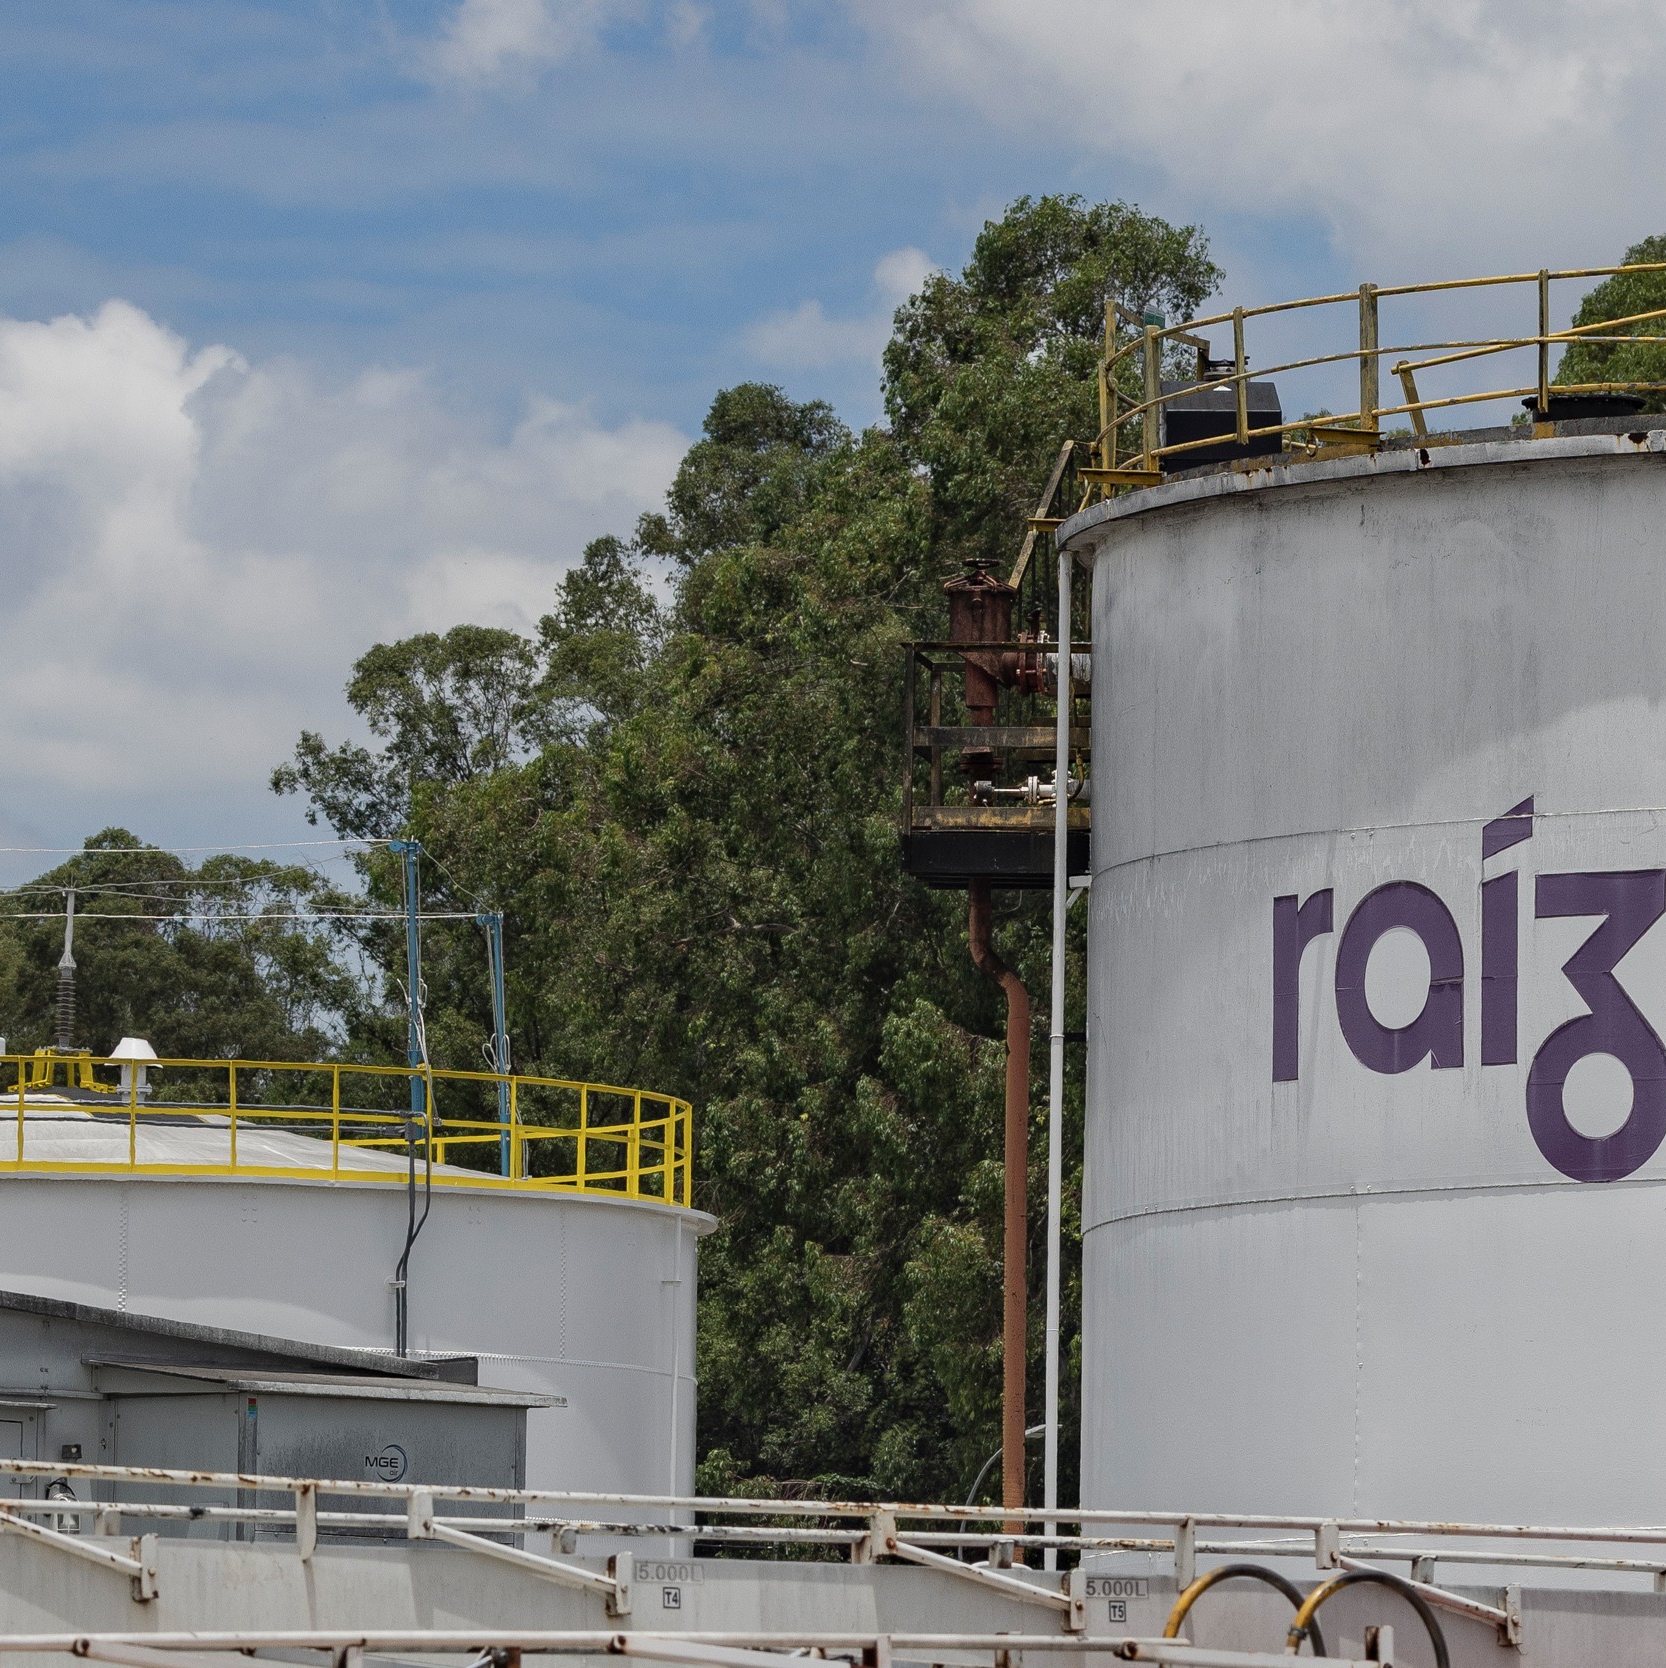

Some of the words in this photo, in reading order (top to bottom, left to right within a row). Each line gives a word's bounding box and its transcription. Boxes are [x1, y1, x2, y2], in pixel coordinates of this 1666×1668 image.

[365, 1456, 399, 1469] MGE
[1086, 1580, 1145, 1597] 5.000L
[664, 1590, 679, 1606] T4
[1110, 1603, 1125, 1620] T5
